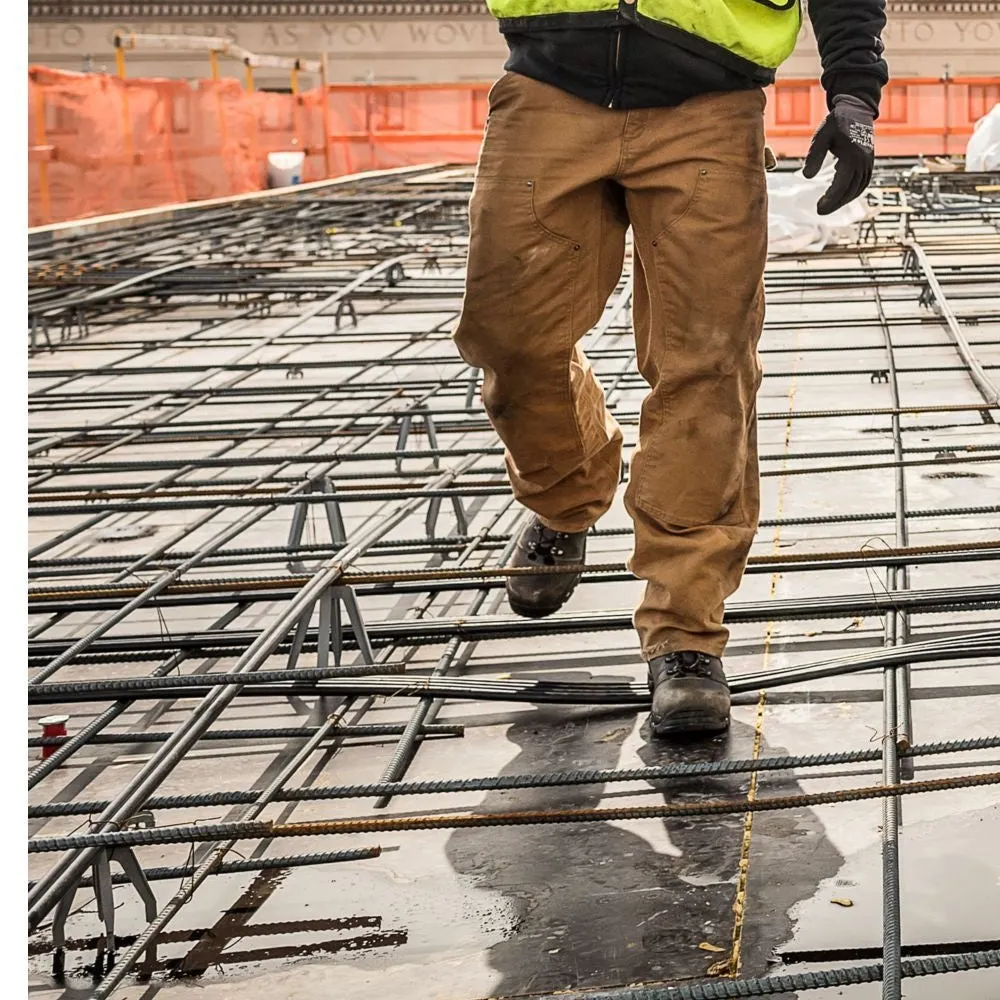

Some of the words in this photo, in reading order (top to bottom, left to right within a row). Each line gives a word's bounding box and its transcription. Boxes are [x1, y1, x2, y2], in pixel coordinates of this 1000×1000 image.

[262, 23, 299, 46] AS
[319, 23, 387, 46] YOV
[407, 22, 498, 46] WOVL
